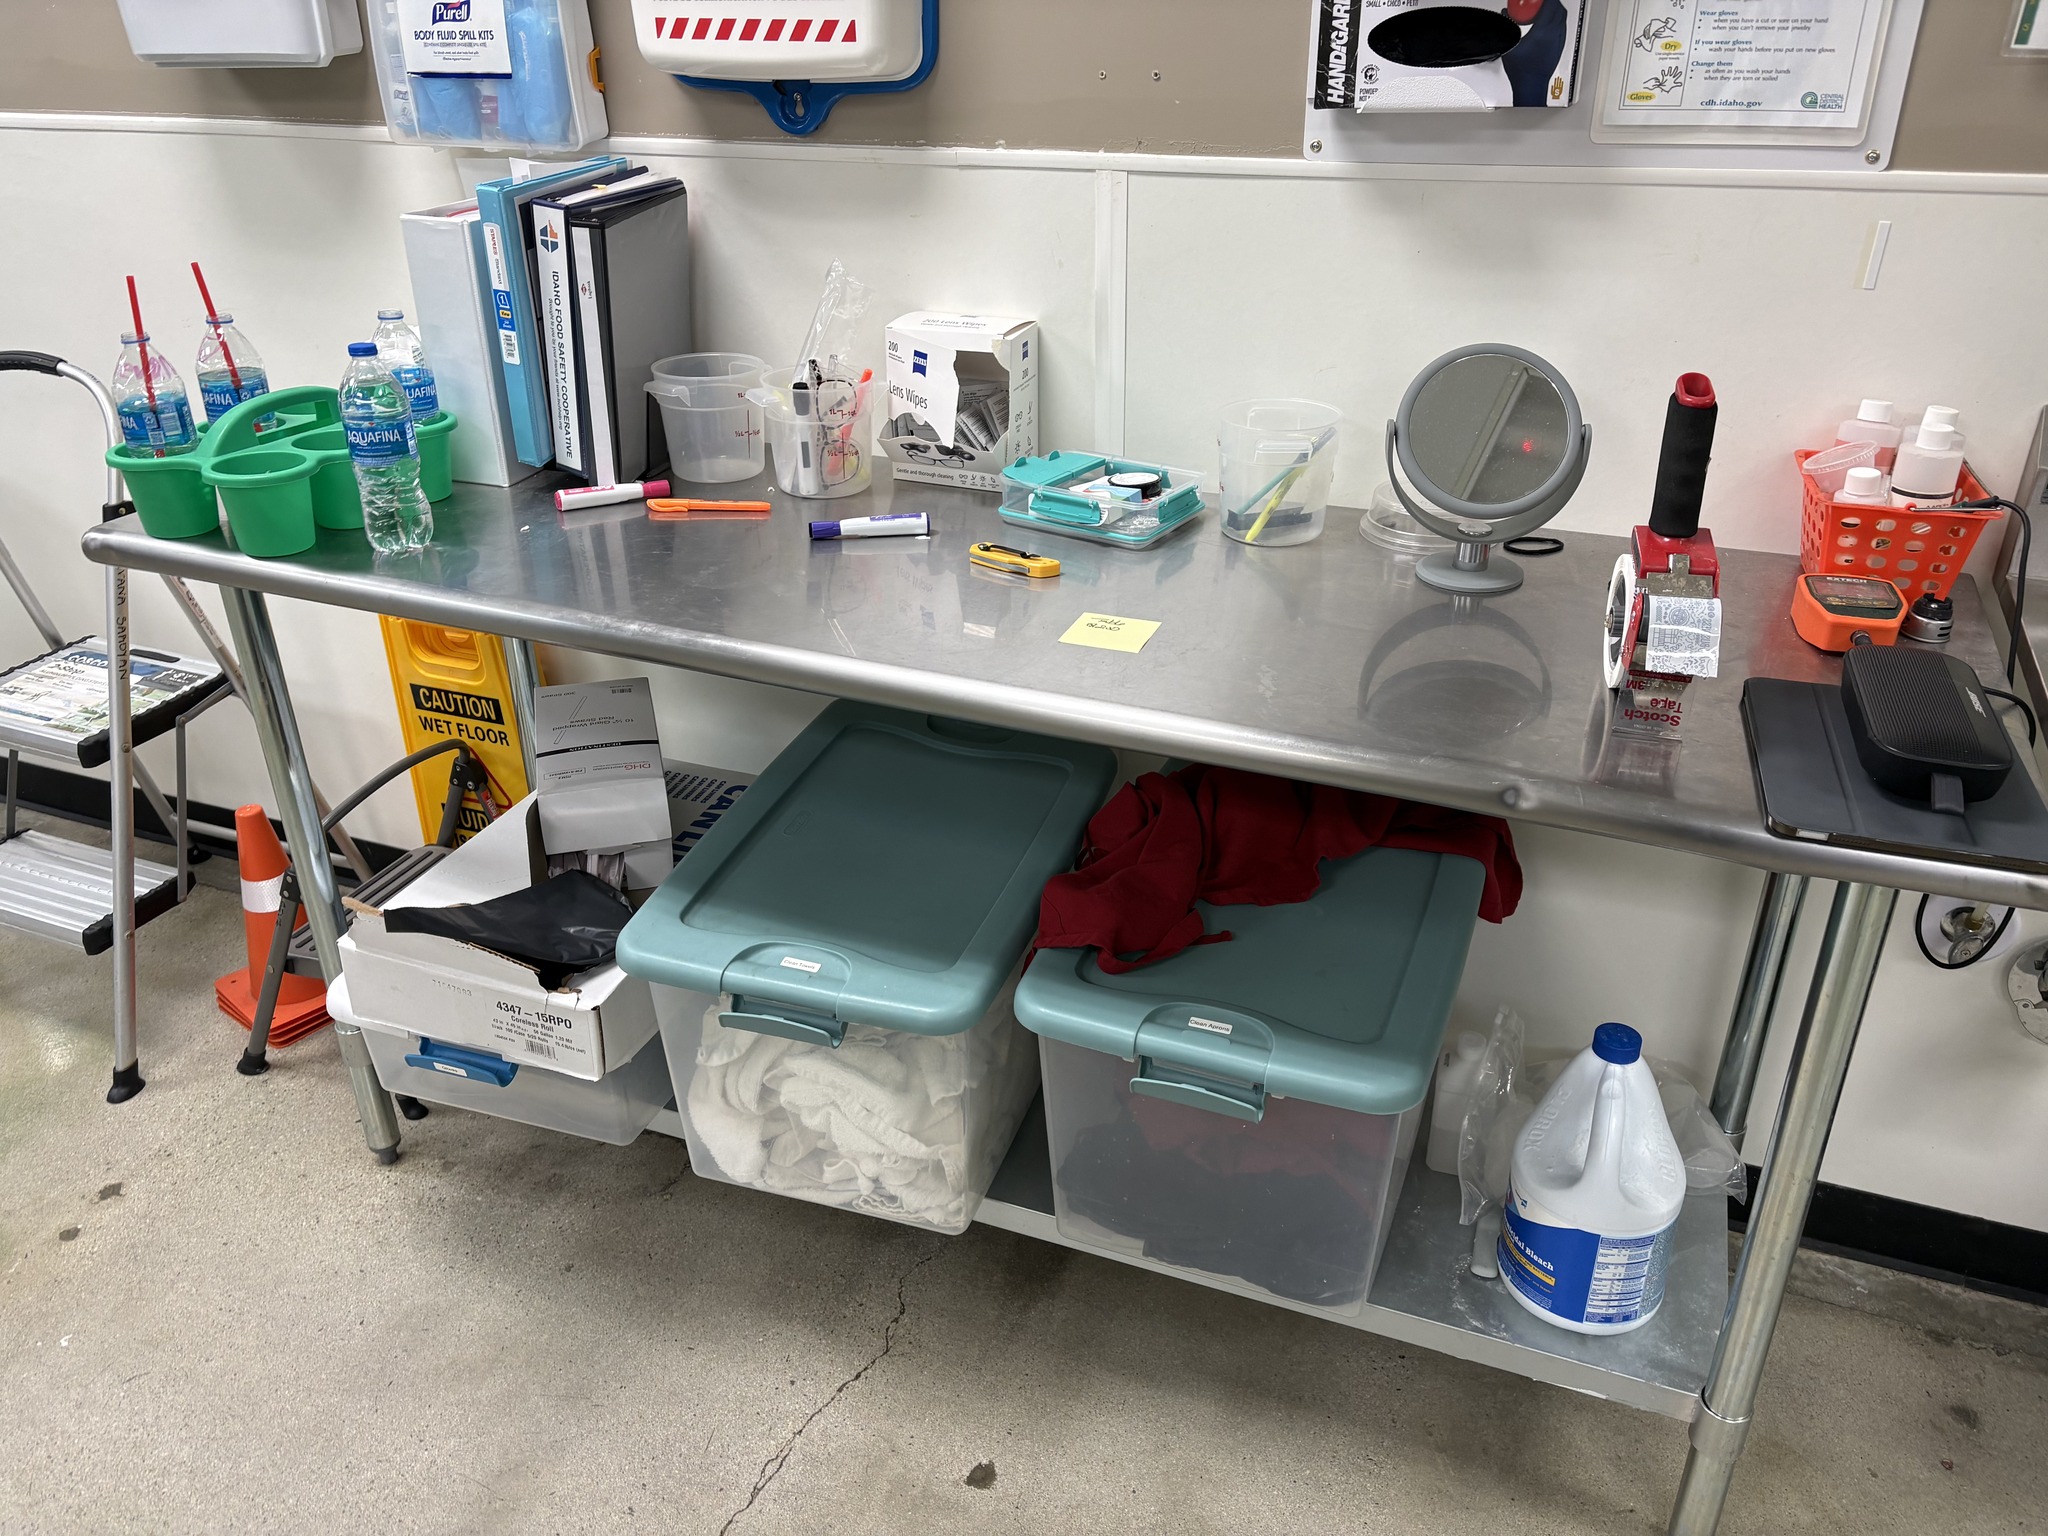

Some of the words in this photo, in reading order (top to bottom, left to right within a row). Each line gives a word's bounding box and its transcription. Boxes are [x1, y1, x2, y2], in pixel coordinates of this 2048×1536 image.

[435, 4, 470, 21] Purell
[413, 30, 435, 41] BODY
[436, 30, 457, 41] FLUID
[458, 30, 477, 41] SPILL
[477, 30, 495, 41] KITS
[1664, 43, 1678, 51] Dry
[1629, 93, 1653, 101] Gloves
[1699, 99, 1763, 109] cdh.idaho.gov
[489, 228, 499, 256] STAPLES
[551, 270, 562, 306] IDAHO
[554, 308, 565, 340] FOOD
[888, 340, 899, 353] 200
[557, 341, 568, 384] SAFETY
[405, 383, 437, 400] UAFINA
[889, 380, 904, 401] Lens
[905, 389, 928, 411] Wipes
[560, 385, 573, 459] COOPERATIVE
[348, 428, 402, 446] AQUAFINA
[896, 467, 909, 475] Gentle
[918, 470, 937, 479] thorough
[937, 472, 955, 481] cleaning
[1626, 679, 1646, 691] 3M
[419, 687, 496, 721] CAUTION
[1650, 697, 1684, 714] Tape
[1966, 686, 1987, 718] BOSE
[589, 719, 611, 727] Giant
[1624, 708, 1681, 727] Scotch
[418, 715, 452, 736] WET
[457, 723, 511, 747] FLOOR
[552, 722, 588, 732] Wrapped
[569, 741, 622, 752] DESTINATION
[624, 763, 651, 771] DHG
[496, 1001, 522, 1016] 4347
[510, 1015, 540, 1029] Coreless
[540, 1023, 555, 1032] Roll
[1189, 1018, 1208, 1028] Clean
[1208, 1022, 1231, 1033] Aprons
[1524, 1246, 1554, 1272] Bleach
